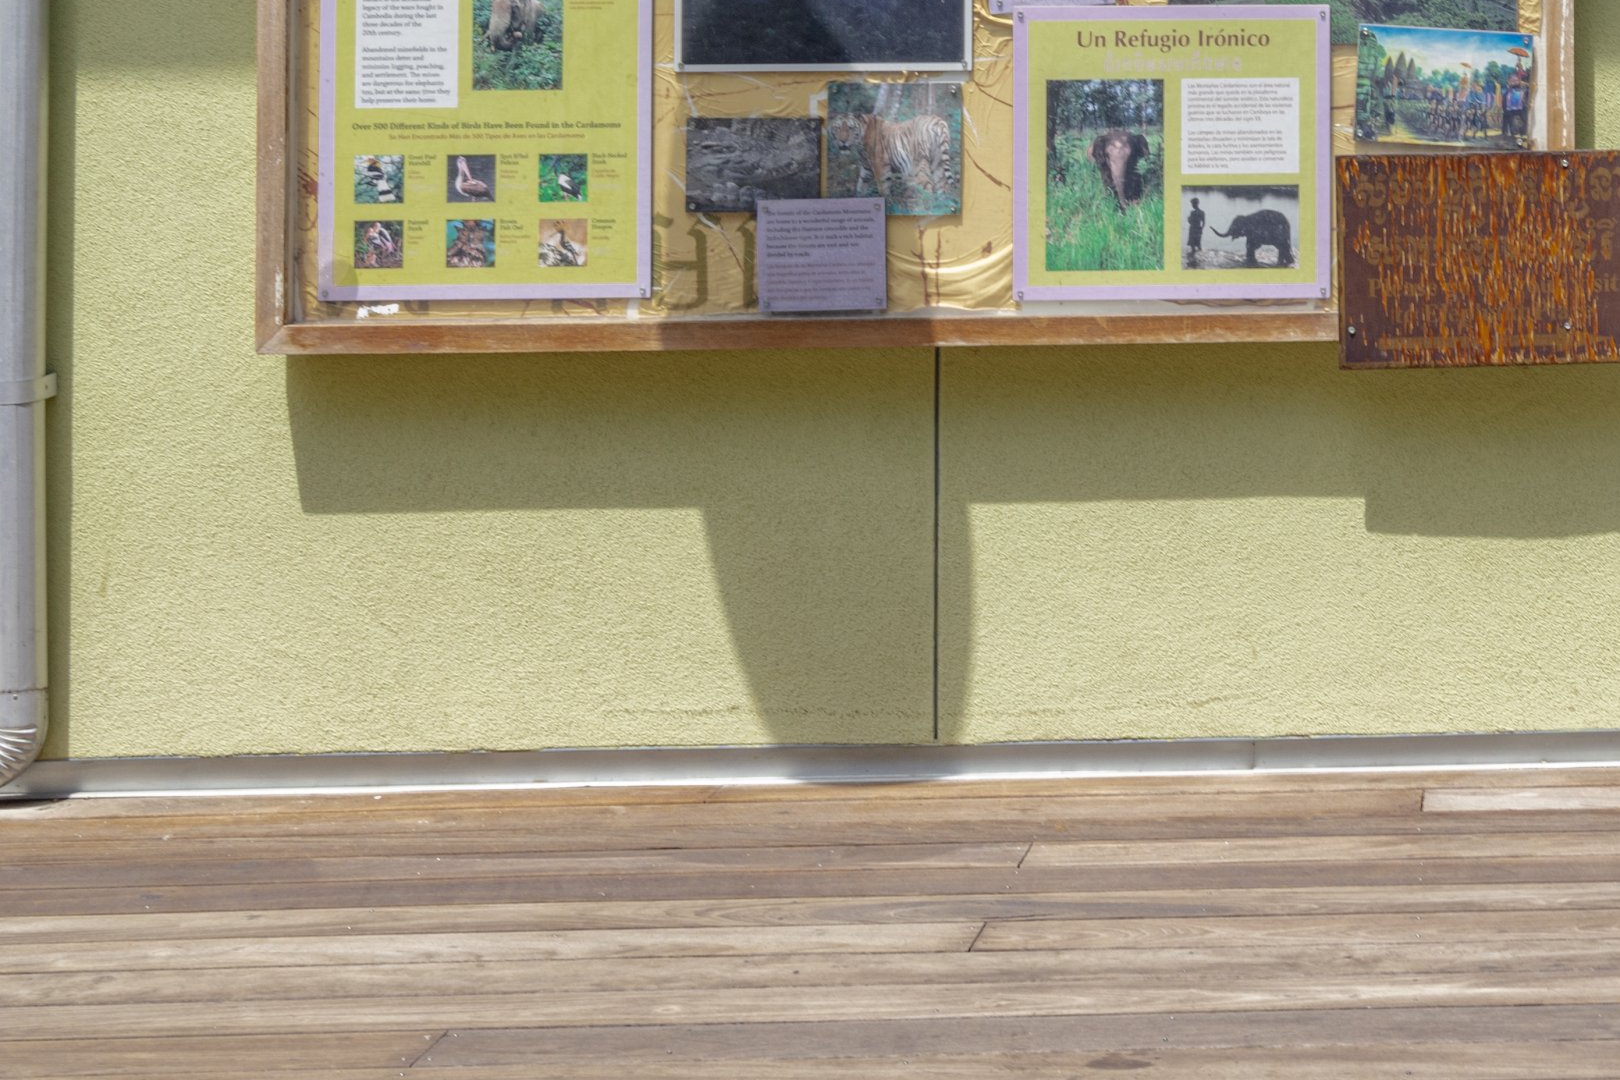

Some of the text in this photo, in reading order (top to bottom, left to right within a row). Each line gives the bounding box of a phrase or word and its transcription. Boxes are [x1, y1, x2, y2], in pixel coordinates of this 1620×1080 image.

[1076, 28, 1271, 53] Un Refugio Irónico
